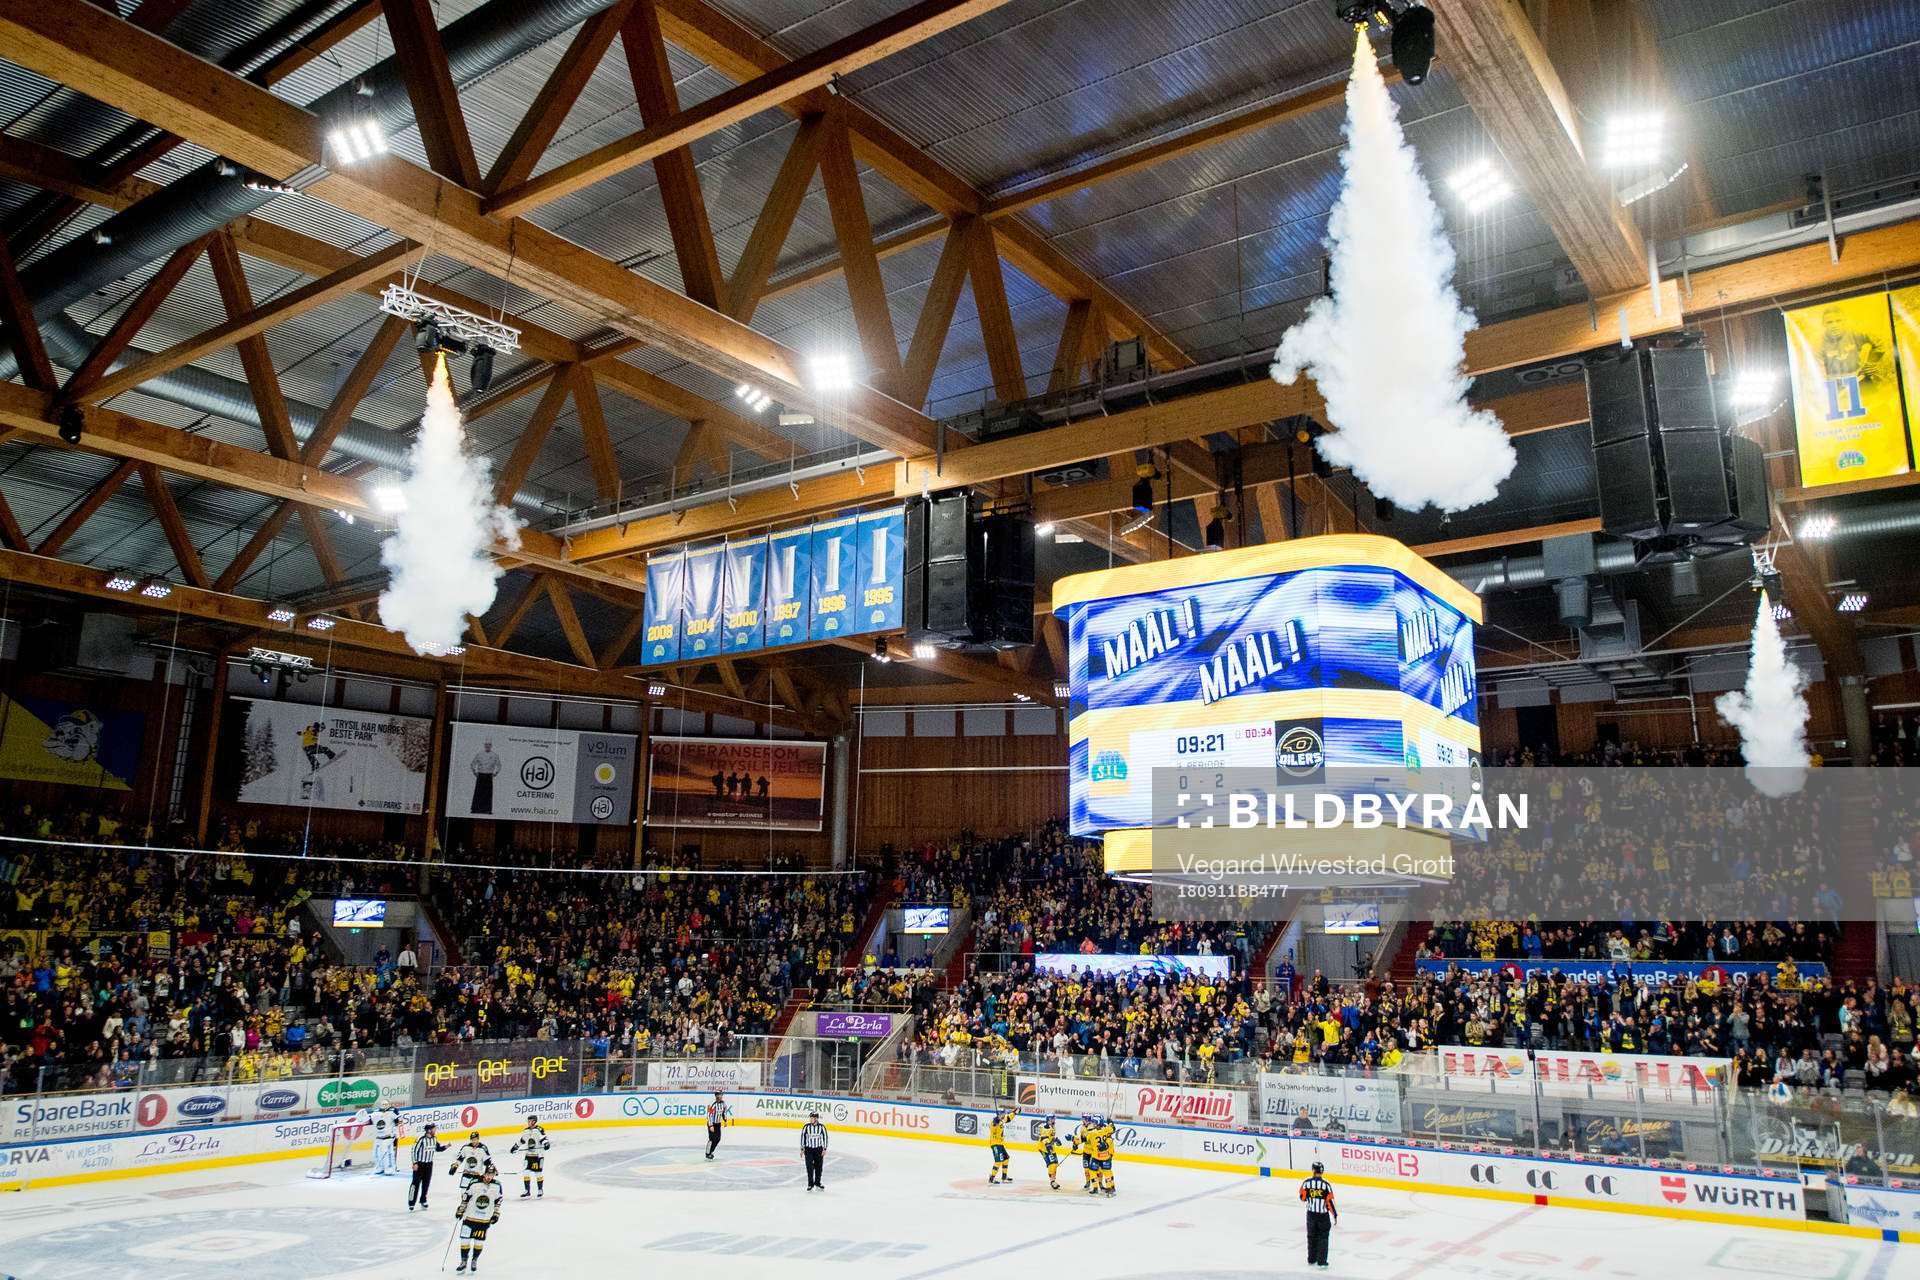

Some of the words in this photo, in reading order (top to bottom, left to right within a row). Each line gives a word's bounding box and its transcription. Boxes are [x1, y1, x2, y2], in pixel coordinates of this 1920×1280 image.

[1824, 376, 1866, 421] 11
[818, 595, 846, 614] 1996
[864, 587, 893, 606] 1995
[729, 611, 757, 628] 2000
[774, 602, 800, 620] 1997
[647, 624, 673, 641] 2008
[687, 619, 715, 635] 2004
[329, 728, 353, 740] BESTE
[652, 743, 799, 760] KONFERANSEROM
[1177, 734, 1225, 754] 09:21
[1278, 752, 1322, 765] OILERS
[1179, 775, 1188, 790] 0
[1215, 773, 1224, 788] 2
[517, 790, 555, 800] CATERING
[510, 806, 560, 816] www.hai.no
[825, 1018, 846, 1031] La
[845, 1015, 884, 1031] Perla
[425, 1062, 460, 1087] get
[478, 1058, 512, 1082] get
[531, 1056, 568, 1079] get
[687, 1065, 737, 1080] Dobloug
[321, 1088, 377, 1101] Specsavers
[1039, 1084, 1096, 1097] Skyttermoen
[184, 1100, 222, 1112] Carrier
[262, 1094, 295, 1105] Carrier
[514, 1100, 573, 1115] SpareBank
[756, 1099, 832, 1113] ARNKVÆRN
[1137, 1087, 1235, 1122] Pizzanini
[16, 1097, 133, 1124] SpareBank
[402, 1108, 459, 1125] SpareBank
[664, 1105, 733, 1116] GJENBK
[855, 1107, 930, 1129] norhus
[14, 1119, 131, 1137] REGNSKAPSHUSET
[135, 1142, 165, 1158] La
[167, 1133, 220, 1154] Perla
[290, 1135, 341, 1146] ØSTLANDT
[1114, 1127, 1167, 1150] Partner
[9, 1148, 51, 1165] RVA
[1342, 1147, 1394, 1163] EIDSIVA
